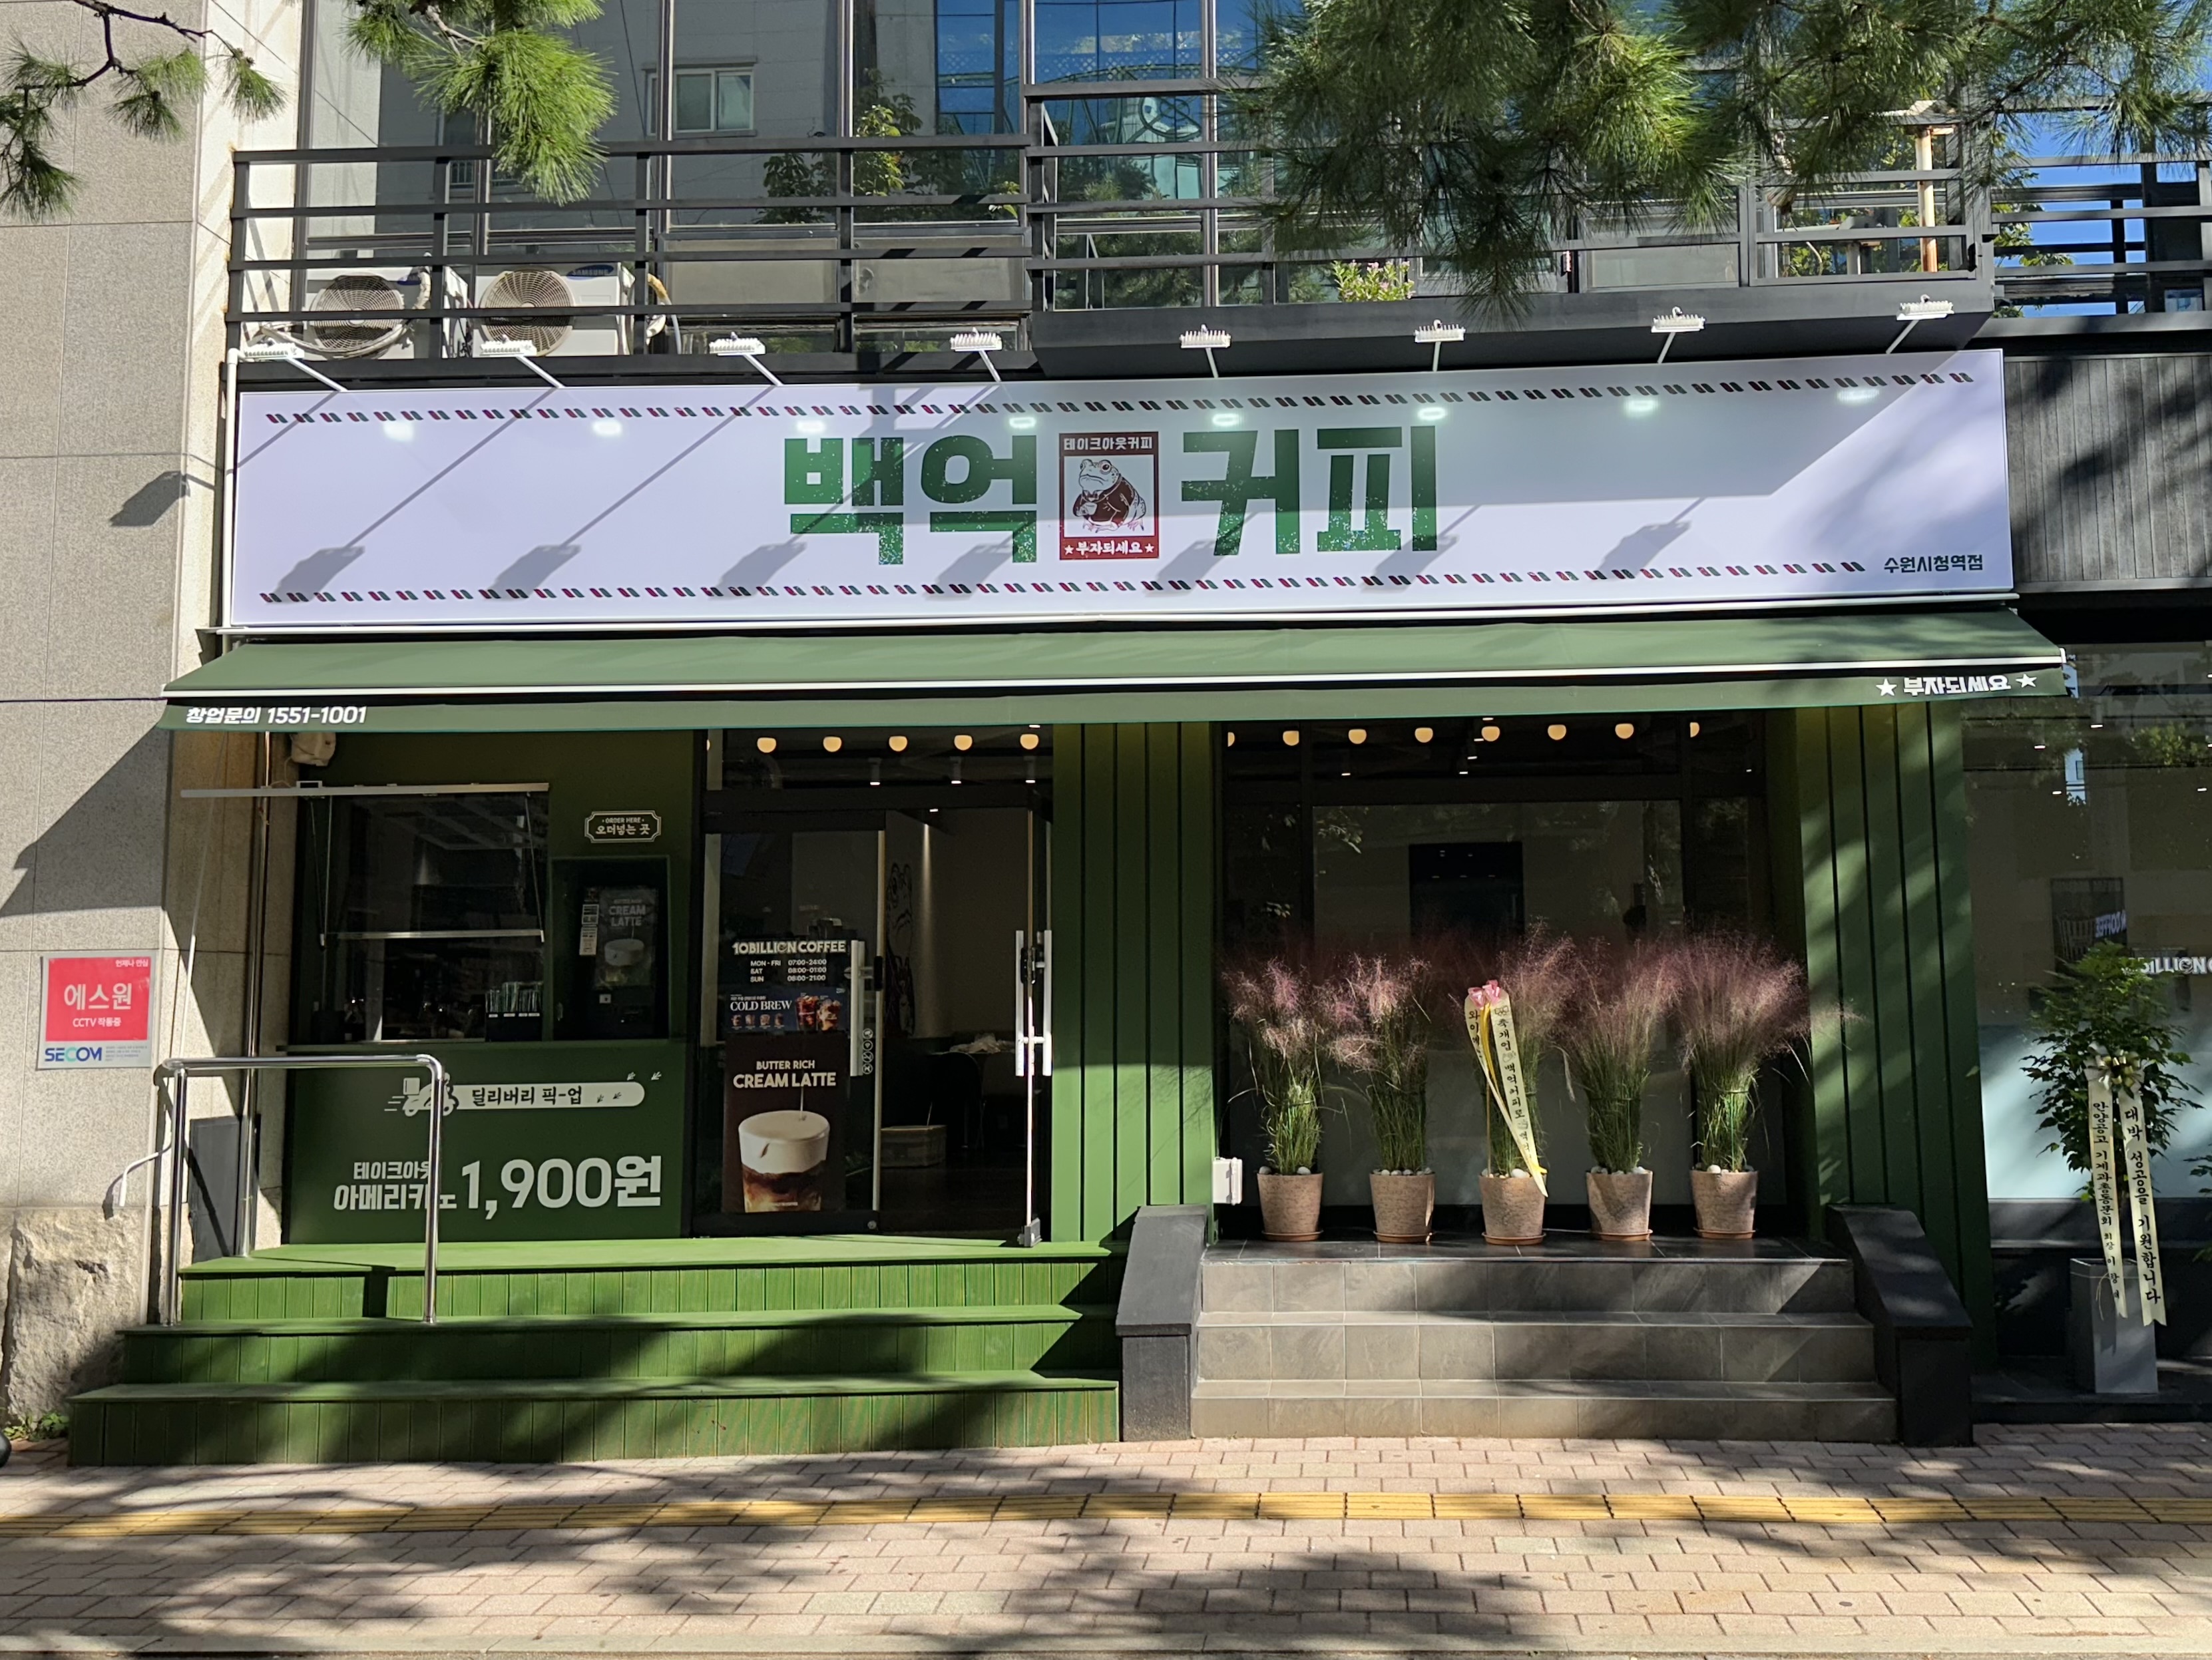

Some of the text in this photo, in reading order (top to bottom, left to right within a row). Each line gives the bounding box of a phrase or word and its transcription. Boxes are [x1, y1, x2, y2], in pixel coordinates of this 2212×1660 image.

[1064, 437, 1153, 451] 테이크아웃커피
[783, 425, 1438, 565] 백억 커피
[1076, 540, 1143, 555] 부자되세요
[1884, 554, 1983, 573] 수원시청역점
[1903, 674, 2012, 697] 부자되세요
[186, 706, 367, 724] 창업문의 1551-1001
[640, 823, 650, 835] 곳
[608, 905, 646, 915] CREAM
[610, 916, 642, 927] LATTE
[732, 940, 847, 955] 10BILLION COFFEE
[64, 983, 132, 1010] 에스원
[730, 1000, 792, 1011] COLD BREW
[73, 1018, 97, 1027] CCTV
[45, 1046, 103, 1062] SECOM
[756, 1060, 815, 1070] BUTTER RICH
[733, 1072, 837, 1089] CREAM LATTE
[472, 1085, 582, 1107] 딜리버리 픽-업
[2092, 1102, 2109, 1144] 안양공고
[2103, 1233, 2115, 1251] 회장
[461, 1155, 662, 1220] 1,900원
[2124, 1106, 2161, 1305] 대박 성공을 기원합니다
